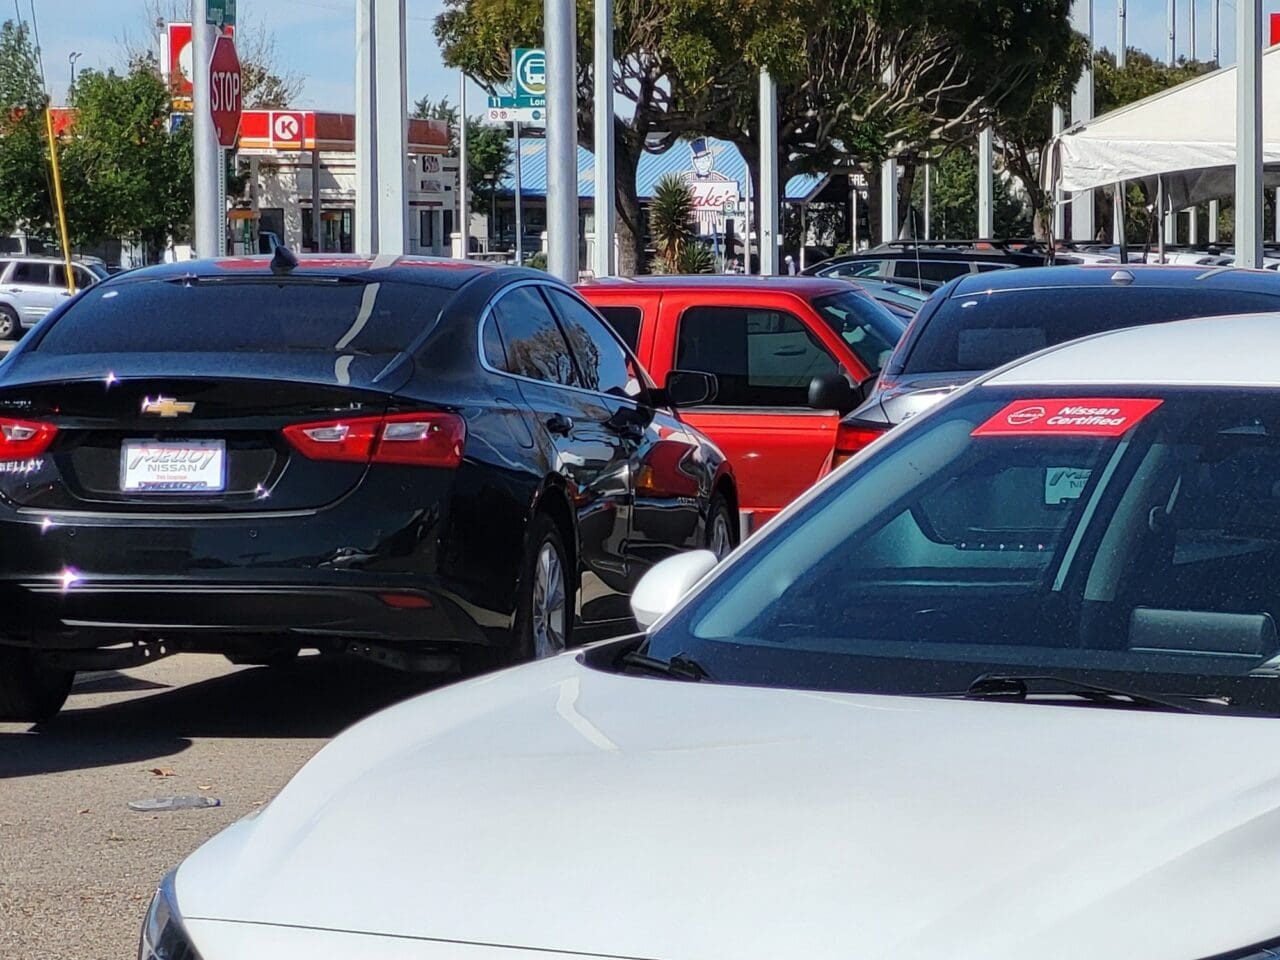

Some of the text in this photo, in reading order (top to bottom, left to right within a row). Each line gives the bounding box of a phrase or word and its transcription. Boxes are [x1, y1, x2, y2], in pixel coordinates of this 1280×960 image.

[212, 72, 240, 112] STOP
[492, 98, 501, 107] 11
[1058, 406, 1120, 416] Nissan
[1047, 416, 1126, 426] Certified
[148, 464, 197, 472] NISSAN
